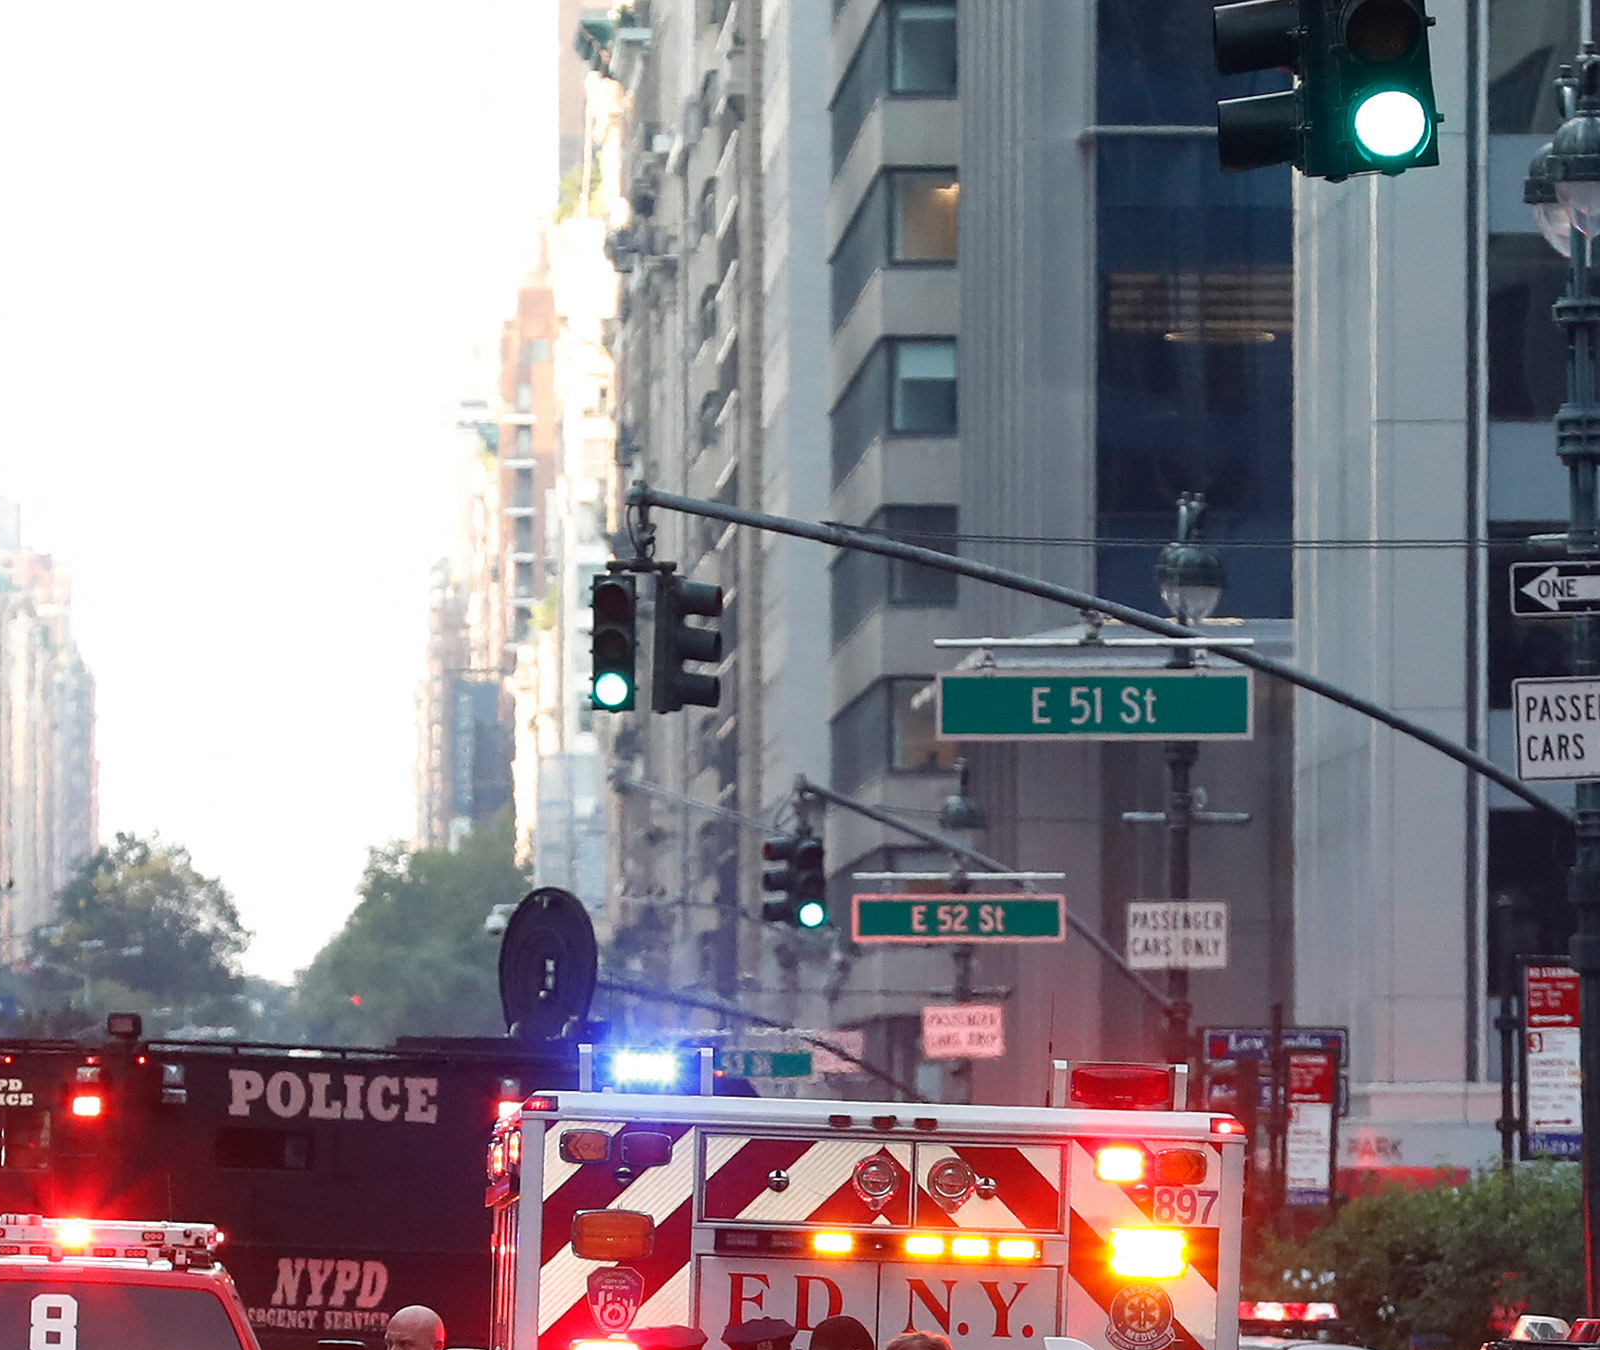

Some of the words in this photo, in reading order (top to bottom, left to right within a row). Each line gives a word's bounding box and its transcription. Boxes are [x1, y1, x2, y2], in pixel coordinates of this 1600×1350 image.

[1537, 577, 1578, 598] ONE
[1032, 687, 1050, 725] E
[1069, 687, 1104, 725] 51
[1120, 687, 1157, 725] St
[1527, 733, 1586, 762] CARS
[911, 905, 927, 932] E
[937, 905, 968, 932] 52
[979, 904, 1005, 932] St
[1132, 910, 1222, 930] PASSENGER
[1133, 936, 1172, 956] CARS
[228, 1068, 439, 1124] POLICE
[1155, 1188, 1220, 1225] 897
[270, 1257, 389, 1309] NYPD
[247, 1307, 318, 1330] ERGENCY
[1124, 1329, 1158, 1342] MEDIC
